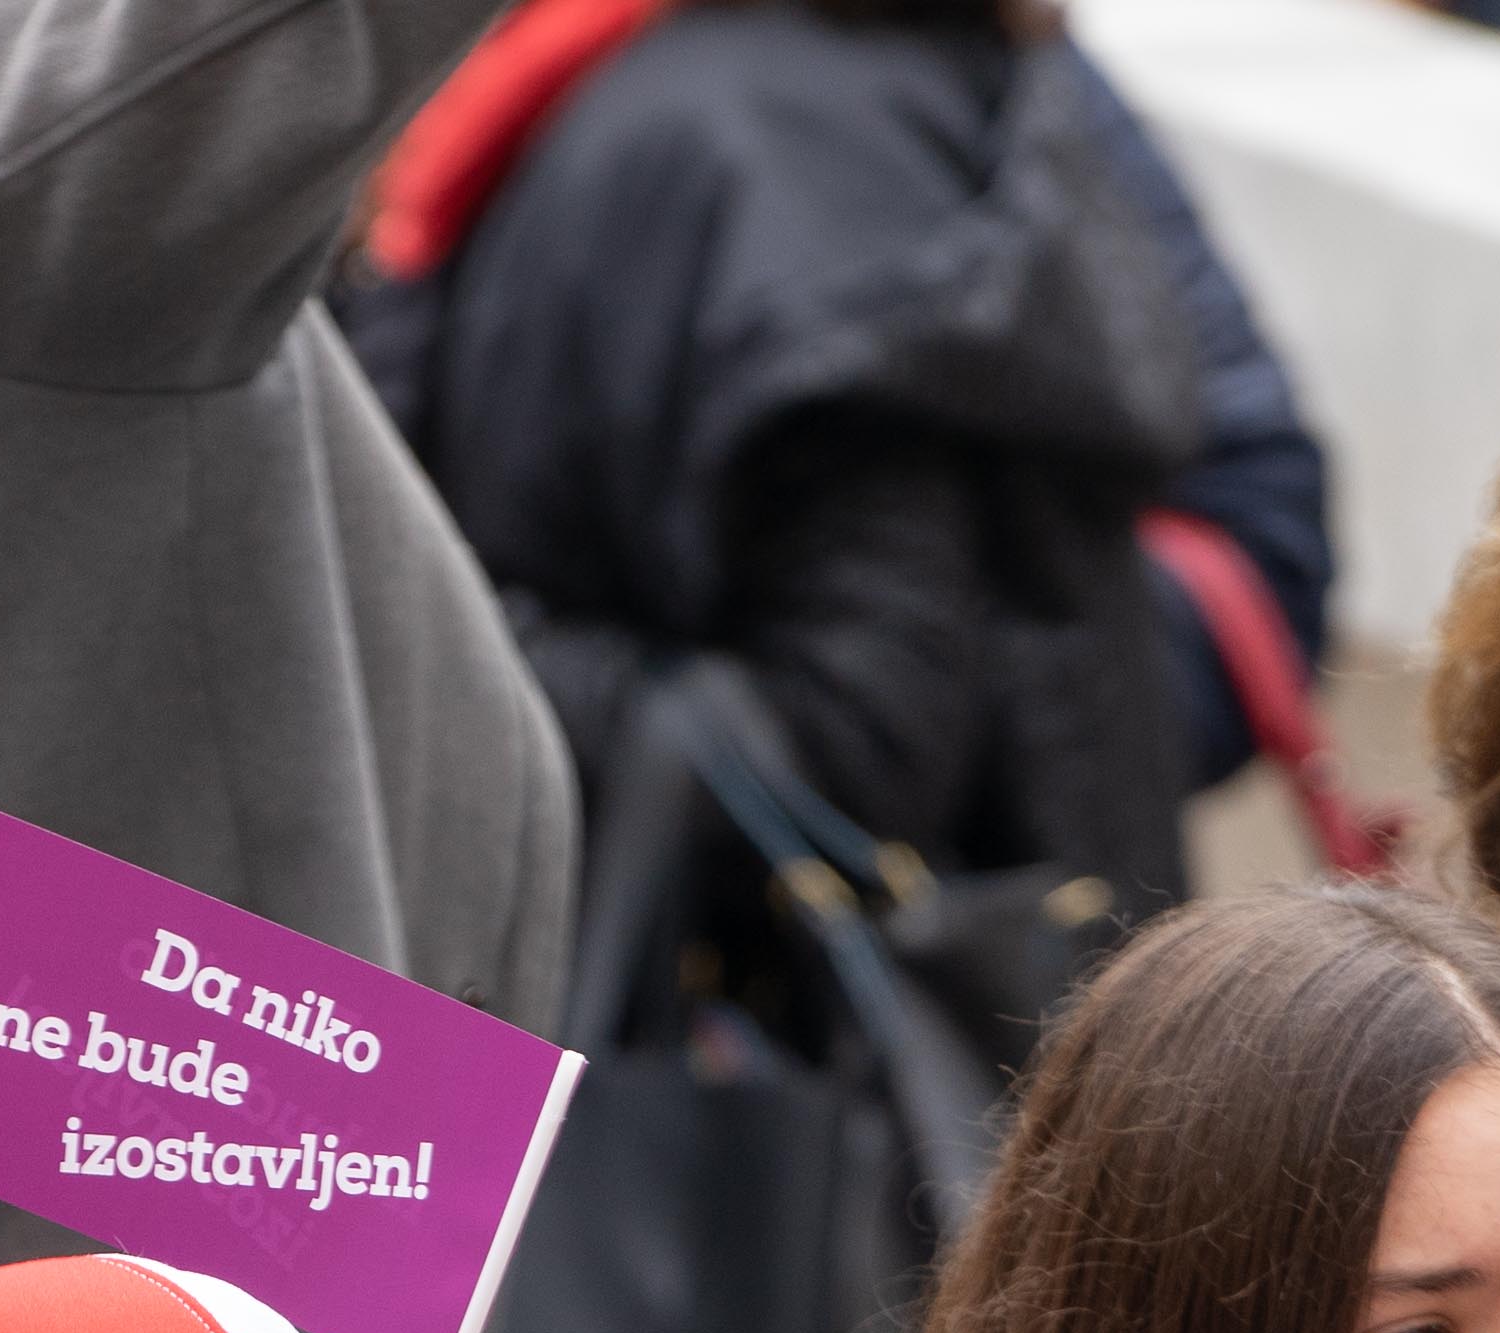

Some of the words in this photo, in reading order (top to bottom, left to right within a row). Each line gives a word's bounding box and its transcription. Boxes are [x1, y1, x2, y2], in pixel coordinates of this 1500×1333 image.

[140, 928, 241, 1016] Da
[243, 985, 381, 1073] niko
[78, 1011, 250, 1105] bude
[59, 1116, 433, 1211] izostavljen!
